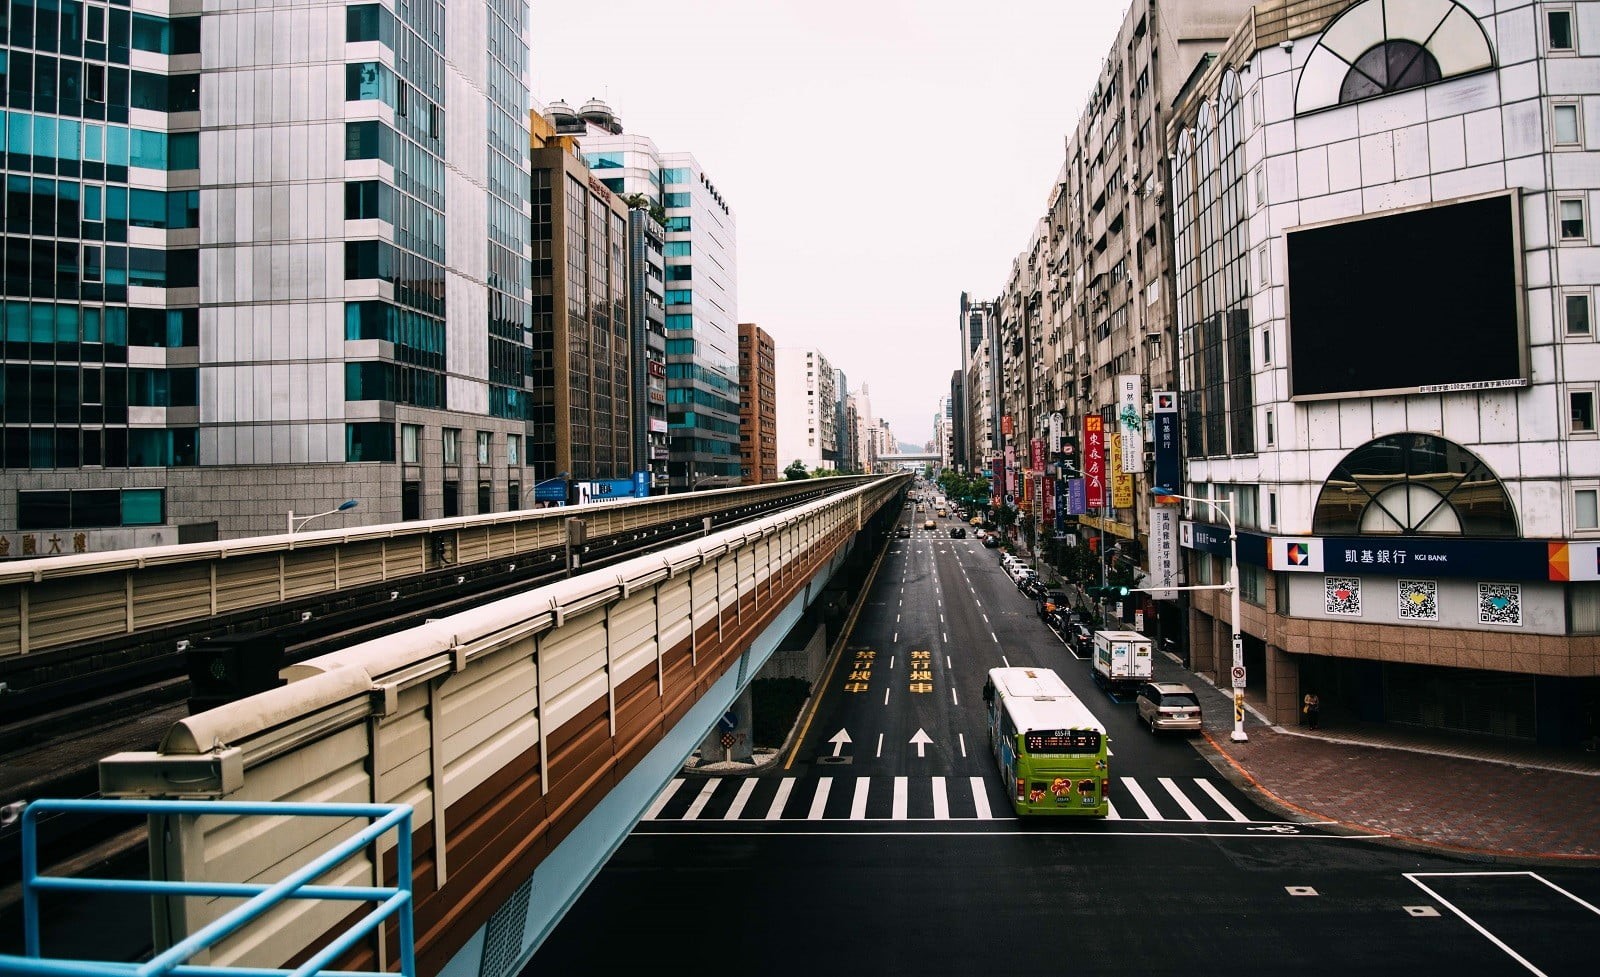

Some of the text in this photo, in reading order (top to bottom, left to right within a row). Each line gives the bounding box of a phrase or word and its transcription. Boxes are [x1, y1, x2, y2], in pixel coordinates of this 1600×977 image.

[1162, 417, 1170, 448] 凱基銀行
[1089, 433, 1102, 488] 東森房屋
[0, 531, 87, 556] 金融大樓
[1345, 549, 1407, 564] 凱基銀行
[1428, 554, 1448, 562] BANK
[843, 651, 877, 693] 禁行機車
[909, 651, 933, 693] 禁行機車
